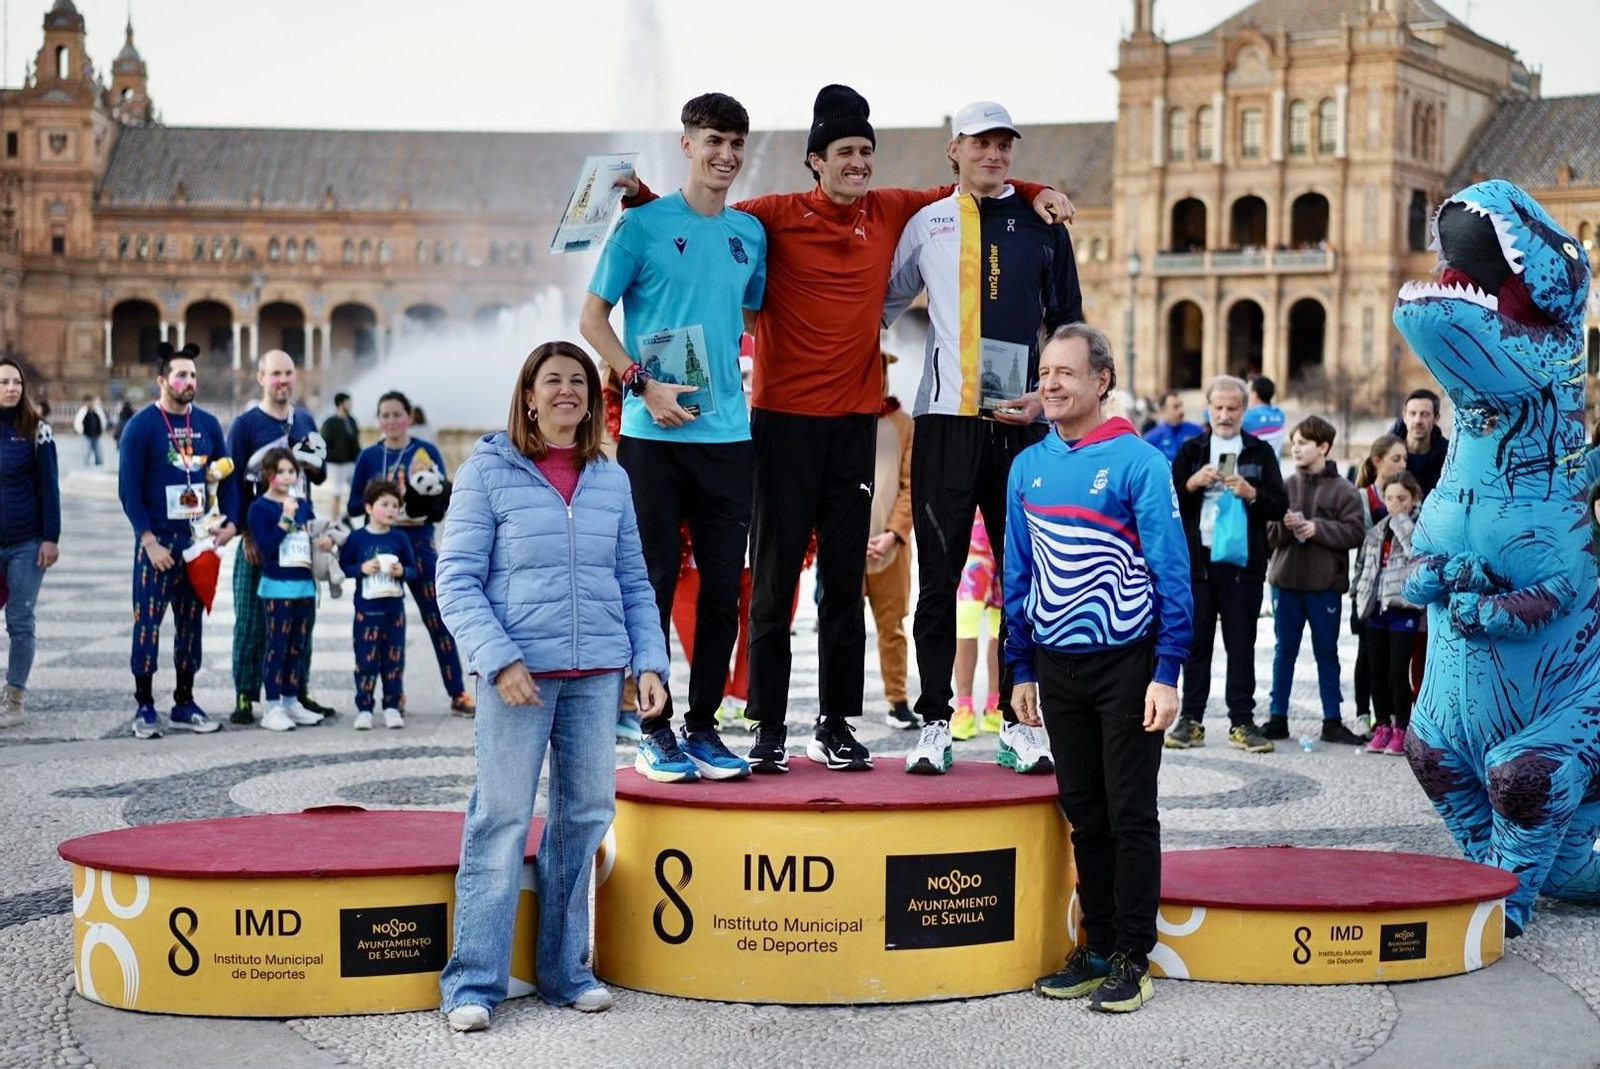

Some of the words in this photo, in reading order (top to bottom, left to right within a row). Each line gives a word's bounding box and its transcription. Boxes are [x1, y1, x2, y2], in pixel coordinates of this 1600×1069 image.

[988, 243, 1000, 300] run2gether
[743, 853, 835, 893] IMD
[907, 895, 998, 912] AYUNTAMIENTO
[235, 908, 302, 937] IMD
[713, 914, 779, 932] Instituto
[783, 917, 863, 935] Municipal
[941, 912, 985, 925] SEVILLA
[1330, 926, 1363, 940] IMD
[357, 936, 432, 950] AYUNTAMIENTO
[736, 937, 758, 951] de
[762, 938, 838, 956] Deportes
[213, 953, 262, 965] Instituto
[265, 954, 324, 967] Municipal
[384, 948, 420, 960] SEVILLA
[1344, 949, 1373, 957] Municipal
[1336, 957, 1364, 965] Deportes
[231, 968, 247, 979] de
[250, 968, 306, 981] Deportes
